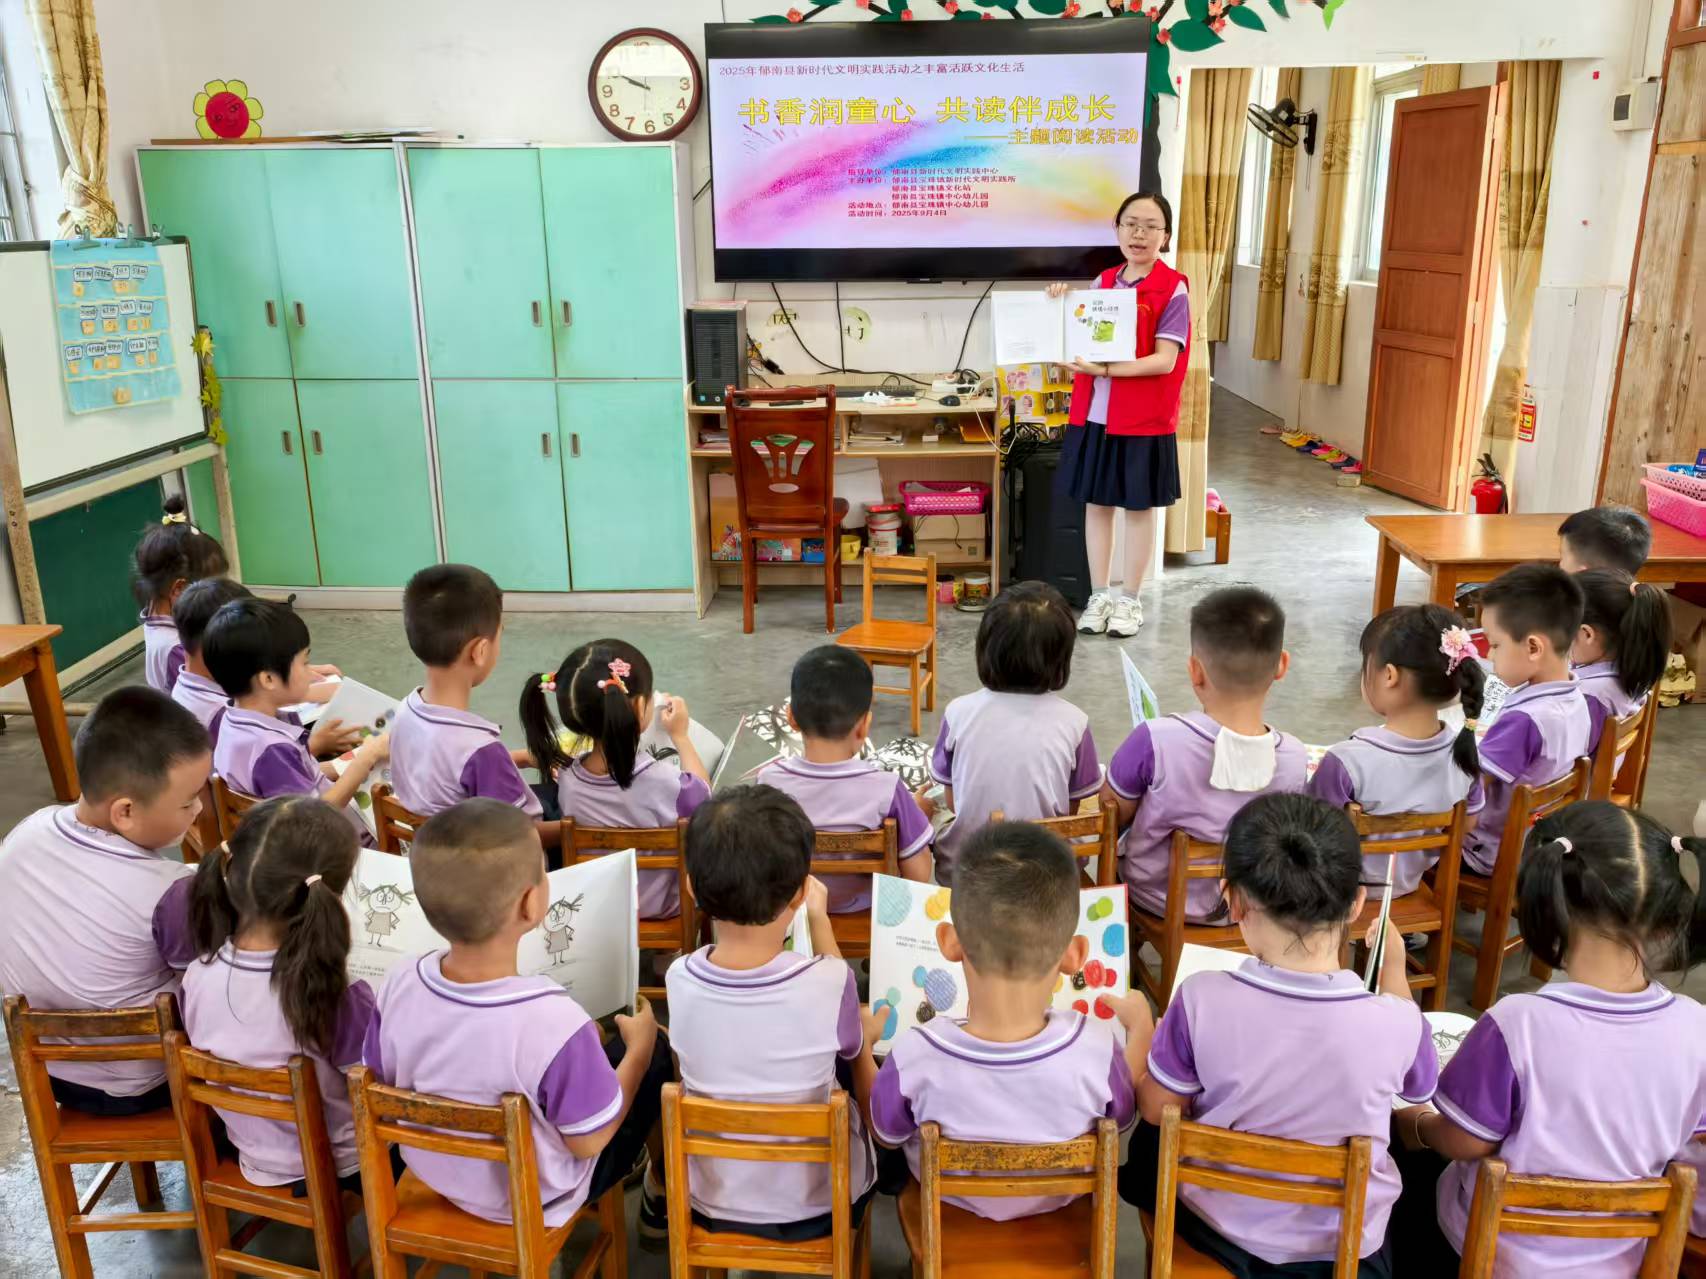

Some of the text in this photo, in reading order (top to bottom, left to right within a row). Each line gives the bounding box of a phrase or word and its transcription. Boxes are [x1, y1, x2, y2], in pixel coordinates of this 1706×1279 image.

[719, 61, 1025, 77] 2025年郁南县新时代文明实践活动之丰富活跃文化生活
[602, 84, 613, 98] 9
[680, 77, 690, 91] 3
[609, 104, 620, 118] 8
[676, 97, 687, 111] 4
[738, 94, 1117, 126] 书香润童心 共读伴成长
[625, 116, 636, 131] 7
[644, 119, 656, 133] 6
[663, 112, 674, 127] 5
